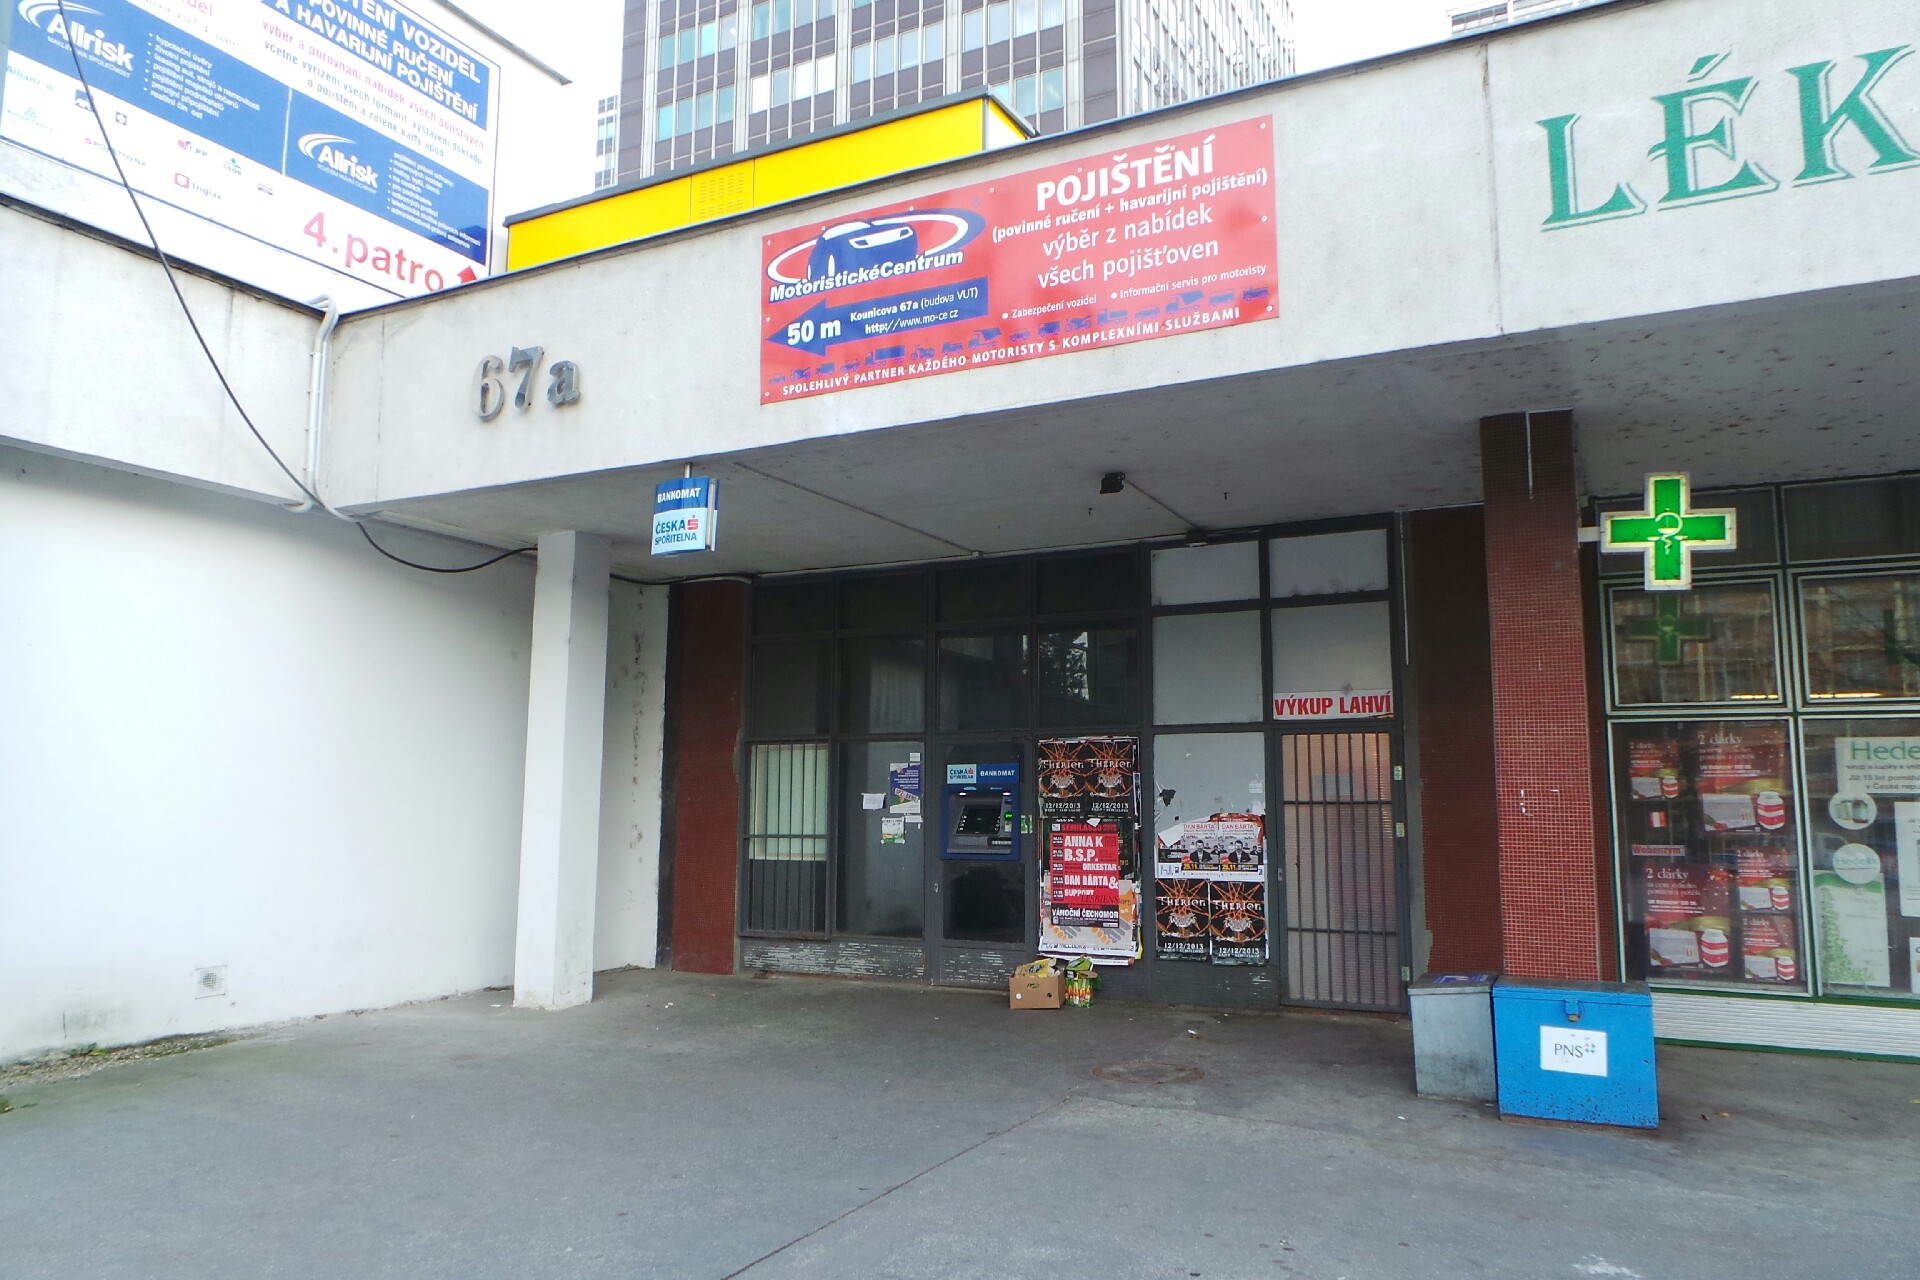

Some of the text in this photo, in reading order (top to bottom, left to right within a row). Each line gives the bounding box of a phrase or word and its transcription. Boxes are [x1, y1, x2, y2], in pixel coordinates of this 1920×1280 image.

[47, 13, 134, 71] Allrisk
[402, 19, 480, 84] VOZIDEL
[275, 0, 478, 122] A HAVARIJNÍ POJIŠTĚNÍ
[393, 39, 454, 88] RUČENÍ
[1535, 44, 1920, 232] LÉK
[318, 145, 379, 188] Allrisk
[1037, 133, 1216, 212] POJIŠTĚNÍ
[191, 181, 222, 201] triglav
[992, 167, 1268, 243] (povinné ručení + havarijní pojištění)
[1043, 202, 1213, 261] výběr z nabídek
[769, 251, 964, 302] MotoristickéCentrum
[1038, 240, 1219, 288] všech pojišťoven
[1120, 264, 1267, 298] Informační servis pro motoristy
[850, 286, 979, 323] Kounicova 67a (budova VUT)
[1012, 294, 1097, 319] Zabezpečení vozidel
[787, 320, 841, 345] 50 m
[782, 306, 1240, 396] SPOLEHLIVÝ PARTNER KAŽDÉHO MOTORISTY S KOMPLEXNÍMI SLUŽBAMI
[473, 346, 582, 422] 67a
[657, 487, 702, 504] BANKOMAT
[655, 516, 686, 535] ČESKÁ
[654, 532, 697, 546] SPOŘITELNA
[1274, 691, 1391, 716] VÝKUP LAHVÍ
[1709, 732, 1743, 747] dárky
[1064, 835, 1094, 847] ANNA
[1095, 835, 1103, 847] K
[1064, 848, 1099, 862] B.S.P.
[1082, 863, 1117, 871] ORKESTAR
[1064, 875, 1080, 886] DAN
[1082, 874, 1108, 886] BÁRTA
[1108, 876, 1119, 889] &
[1645, 868, 1689, 880] 2 dárky
[1052, 907, 1119, 919] VÁNOČNÍ ČECHOMOR
[1164, 942, 1204, 950] 12/12/2013
[1555, 1043, 1583, 1058] PNS
